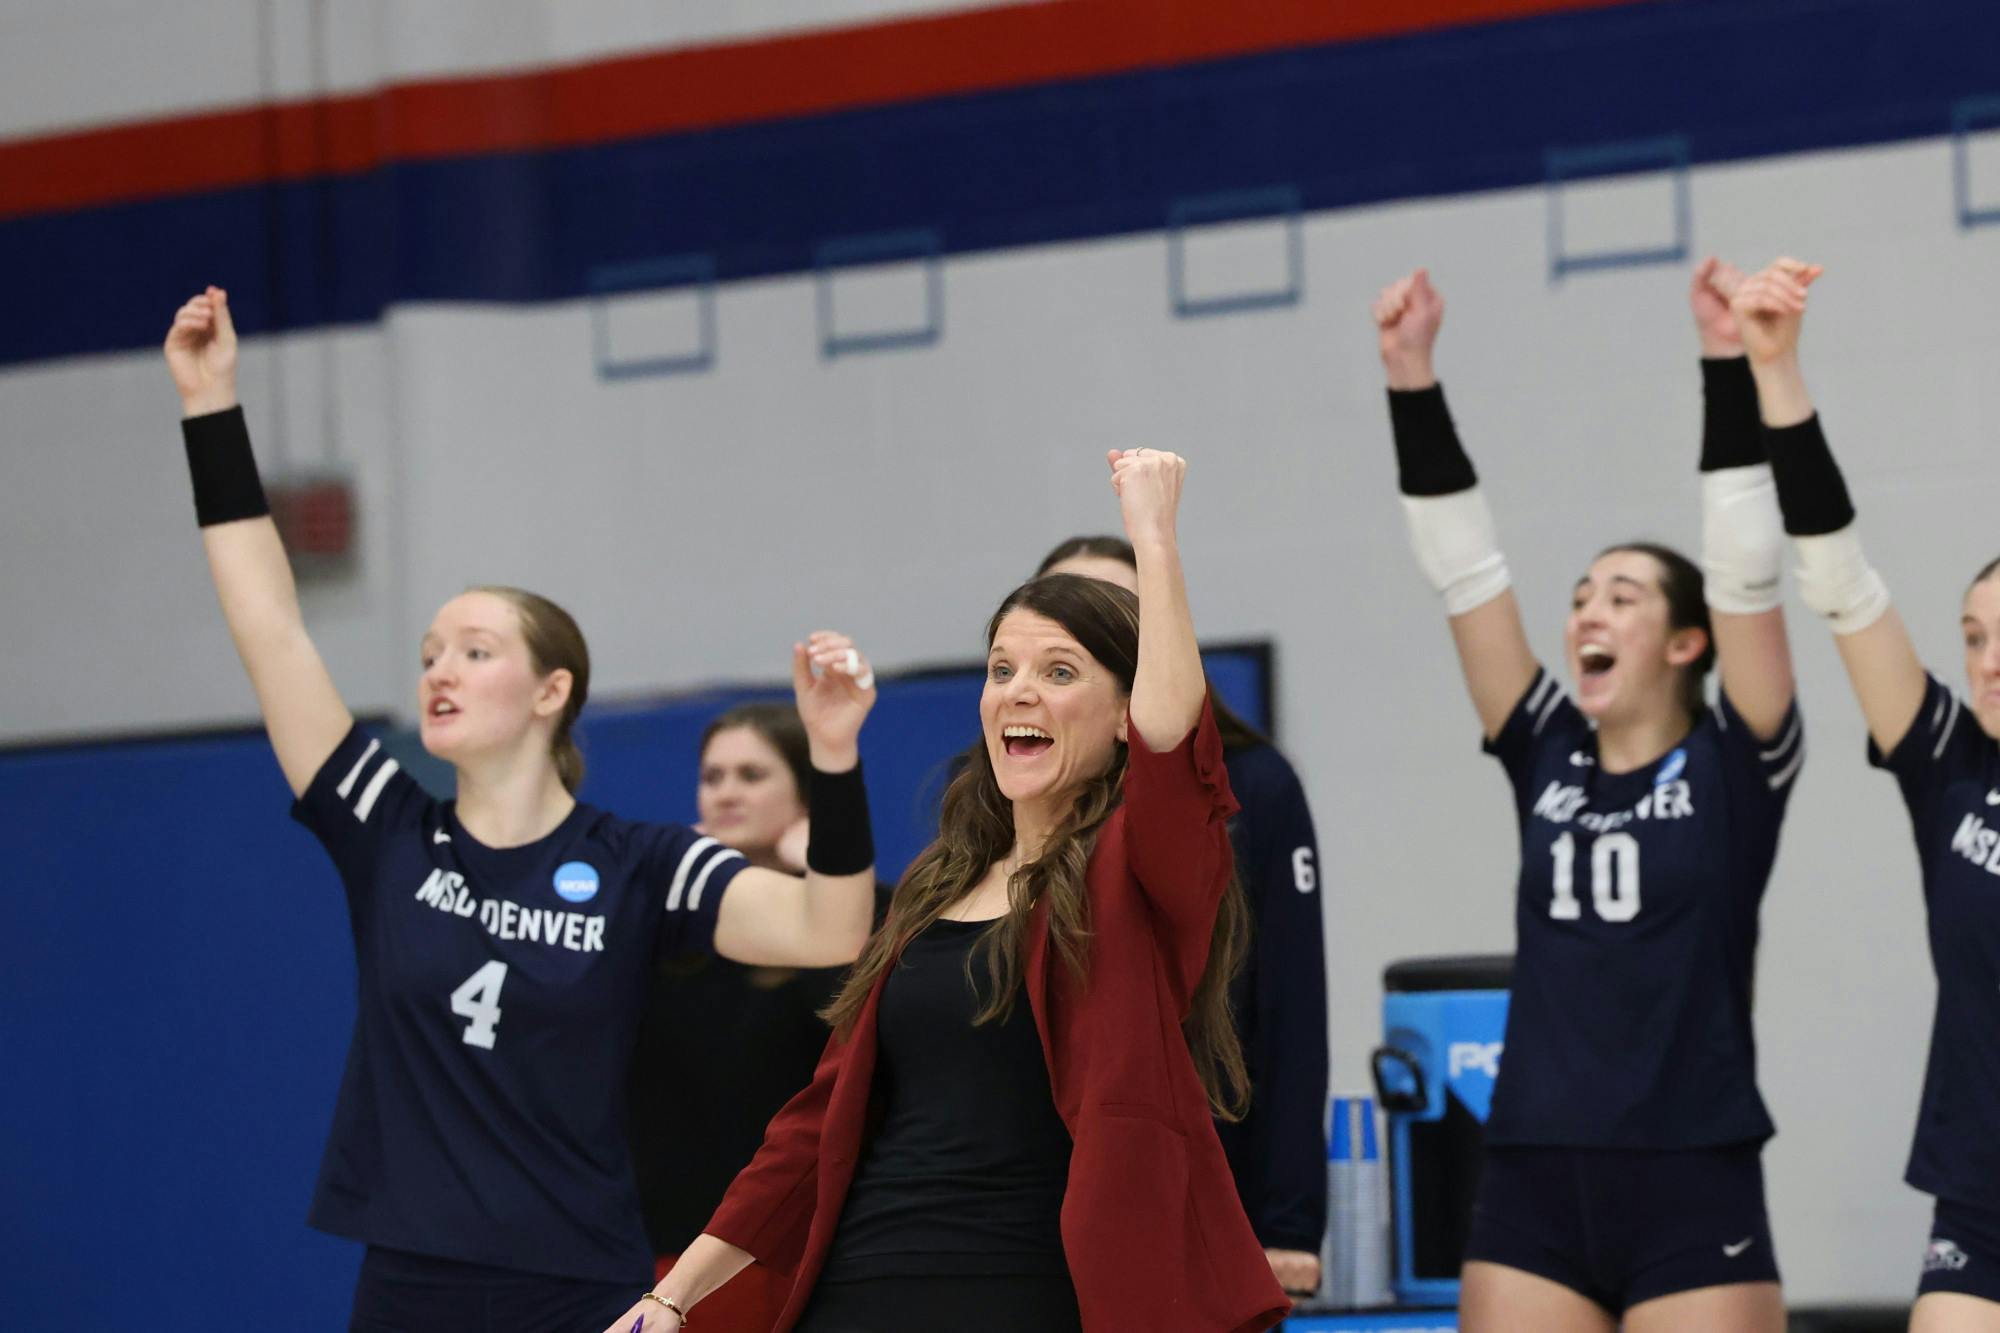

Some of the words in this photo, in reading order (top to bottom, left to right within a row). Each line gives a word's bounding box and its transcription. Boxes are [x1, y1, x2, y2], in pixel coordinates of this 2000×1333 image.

[1291, 846, 1316, 894] 6
[1549, 831, 1641, 923] 10
[479, 899, 606, 952] DENVER
[450, 959, 509, 1050] 4
